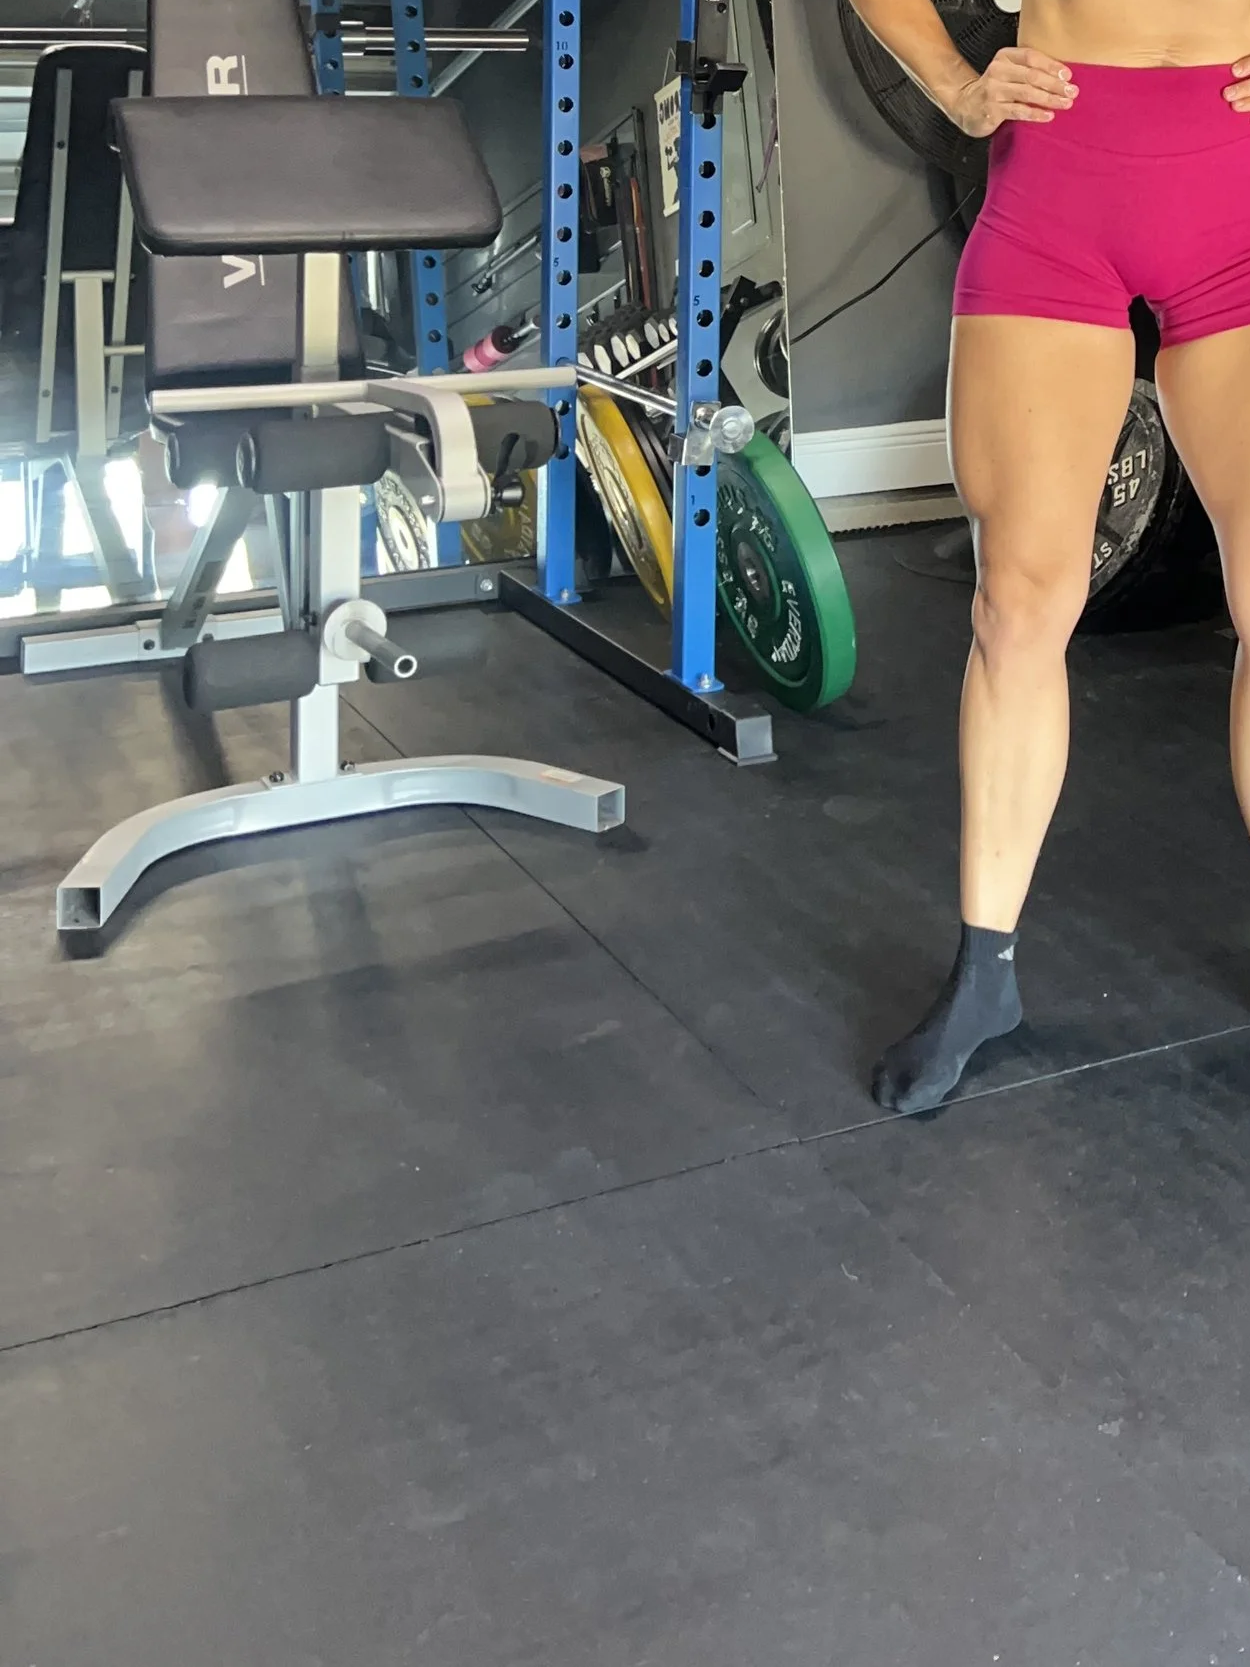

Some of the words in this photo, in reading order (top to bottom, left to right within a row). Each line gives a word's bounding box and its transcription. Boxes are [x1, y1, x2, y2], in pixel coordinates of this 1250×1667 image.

[556, 40, 569, 51] 10
[692, 295, 700, 306] 5
[1108, 449, 1147, 485] LBS
[1114, 477, 1140, 507] 45
